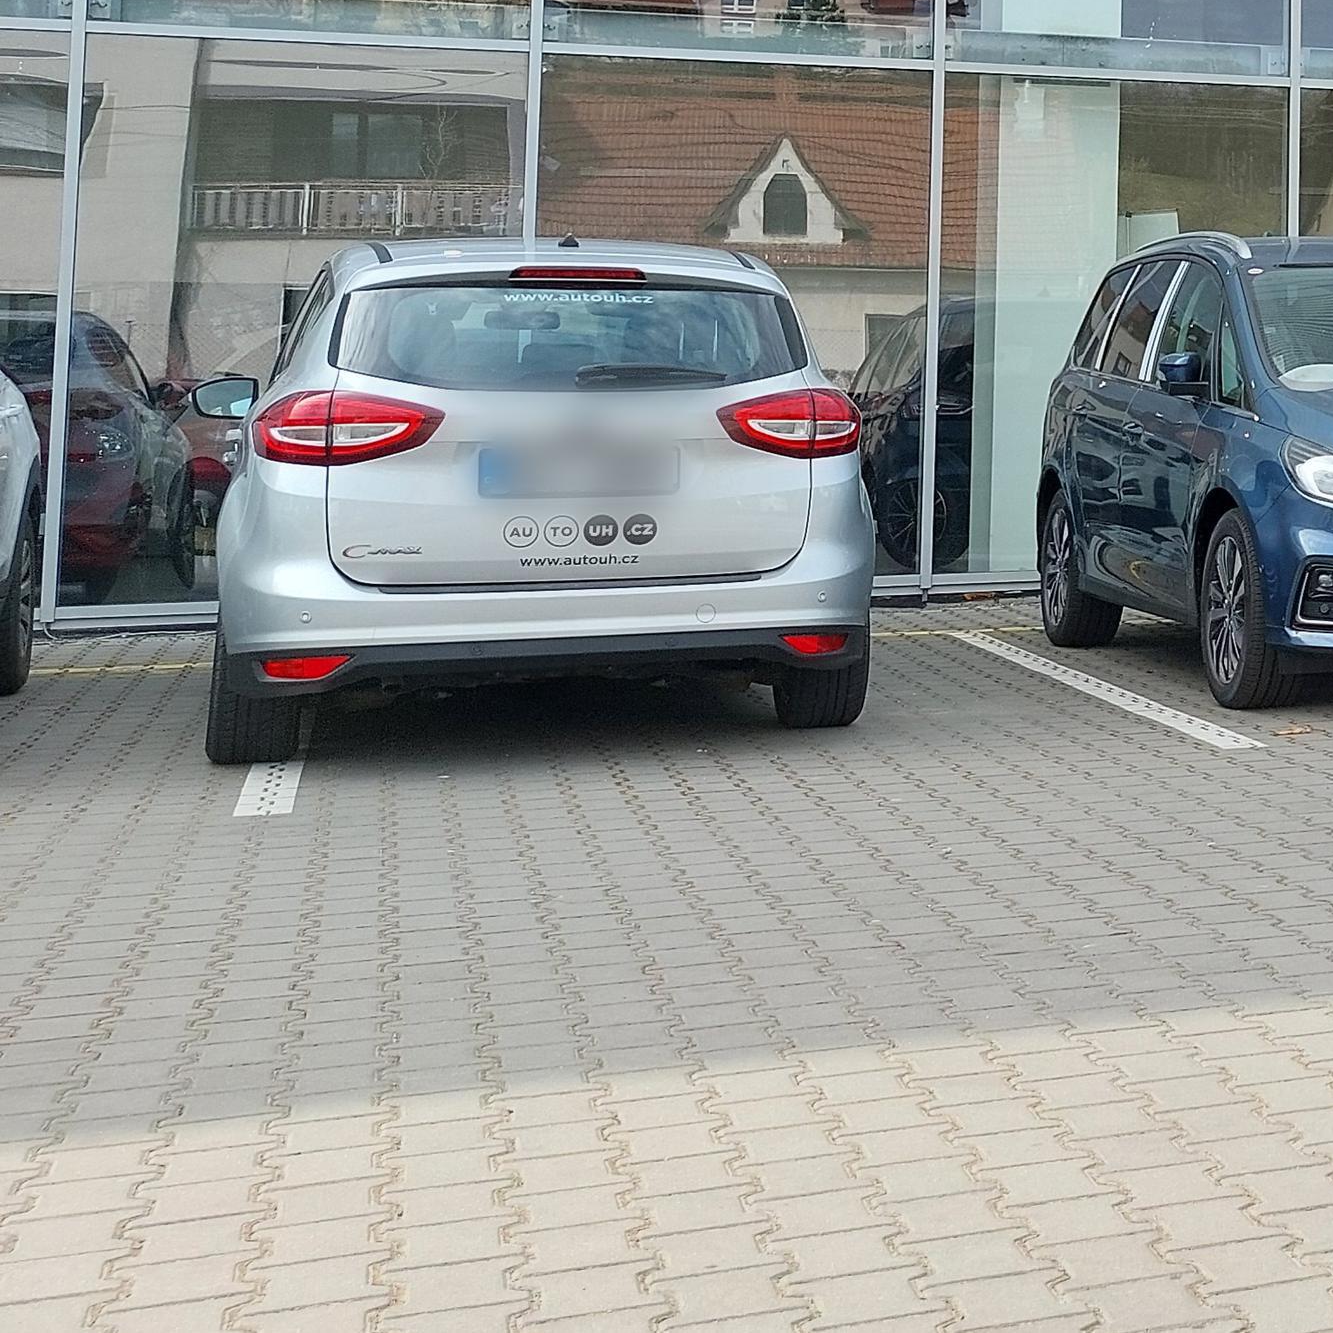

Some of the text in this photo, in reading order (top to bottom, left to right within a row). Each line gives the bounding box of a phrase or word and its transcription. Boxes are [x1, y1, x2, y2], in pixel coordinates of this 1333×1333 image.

[503, 293, 654, 304] www.autouh.cz
[509, 523, 654, 538] AU TO UH .CZ
[519, 553, 640, 567] www.autouh.cz
